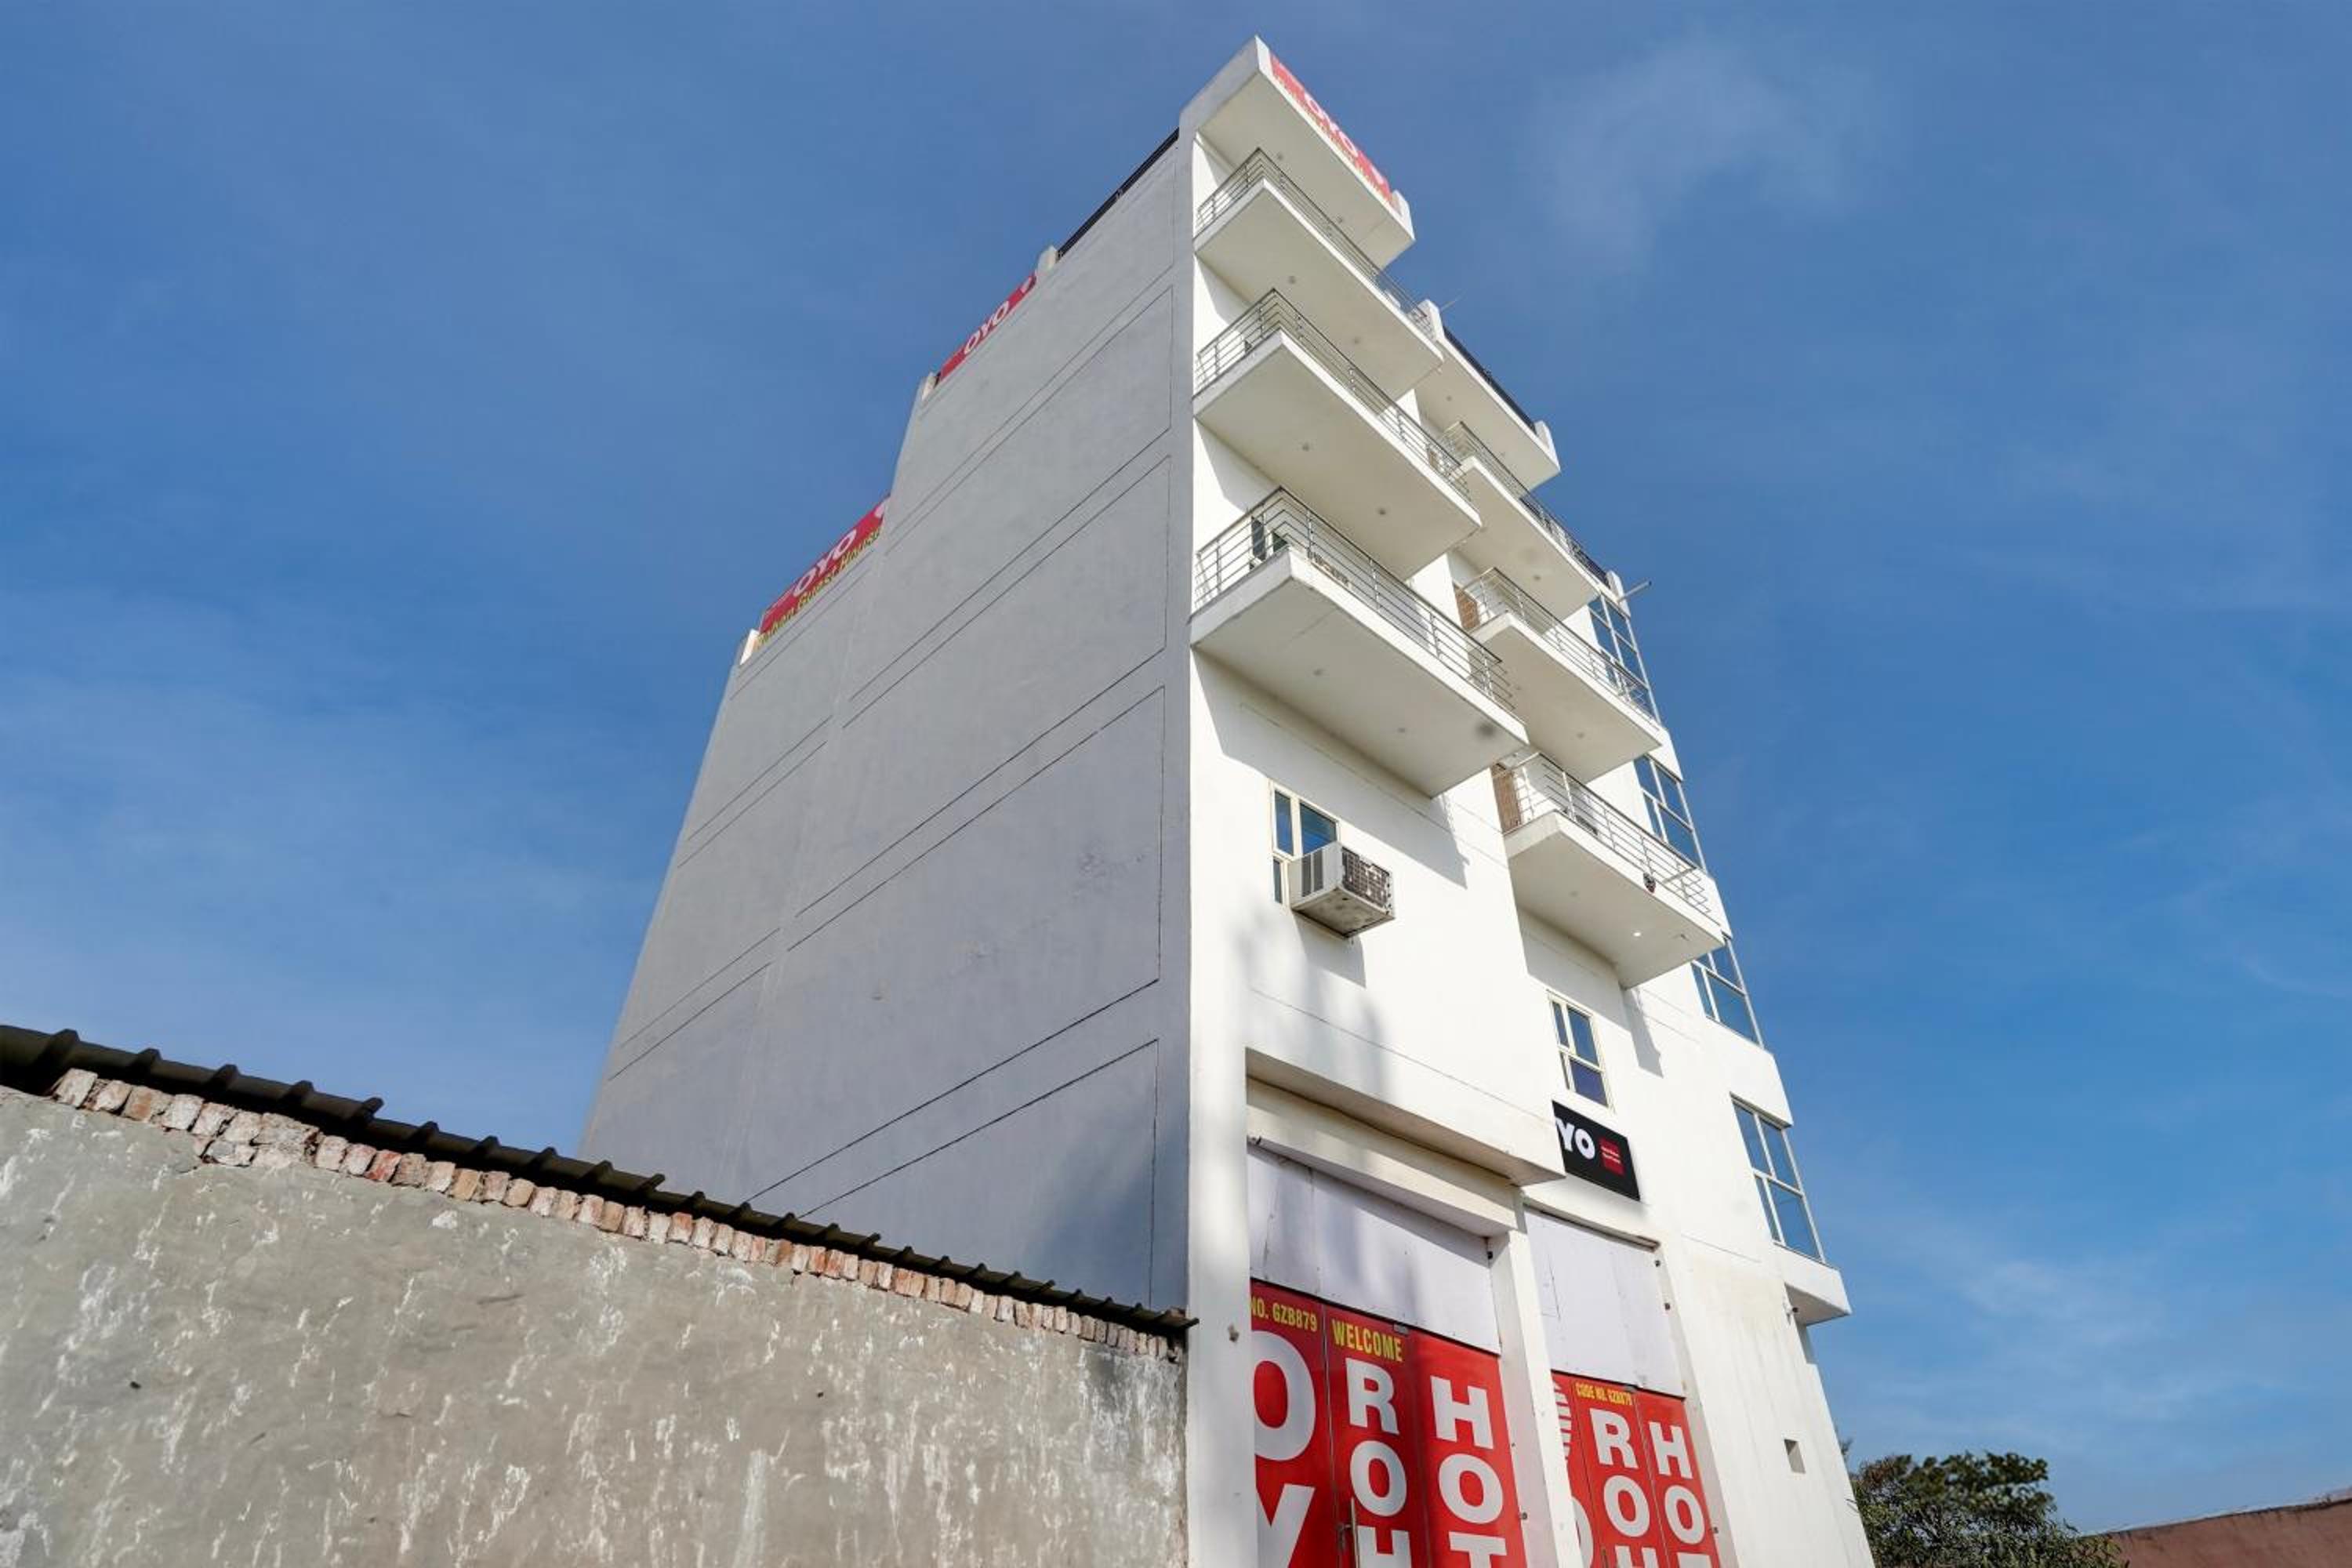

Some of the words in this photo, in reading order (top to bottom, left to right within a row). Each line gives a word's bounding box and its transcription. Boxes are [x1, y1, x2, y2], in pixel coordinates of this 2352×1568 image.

[964, 300, 1009, 354] OYO
[793, 529, 857, 597] OYO
[1555, 1116, 1595, 1160] YO
[1272, 1302, 1318, 1332] GZB879
[1332, 1319, 1403, 1363] WELCOME
